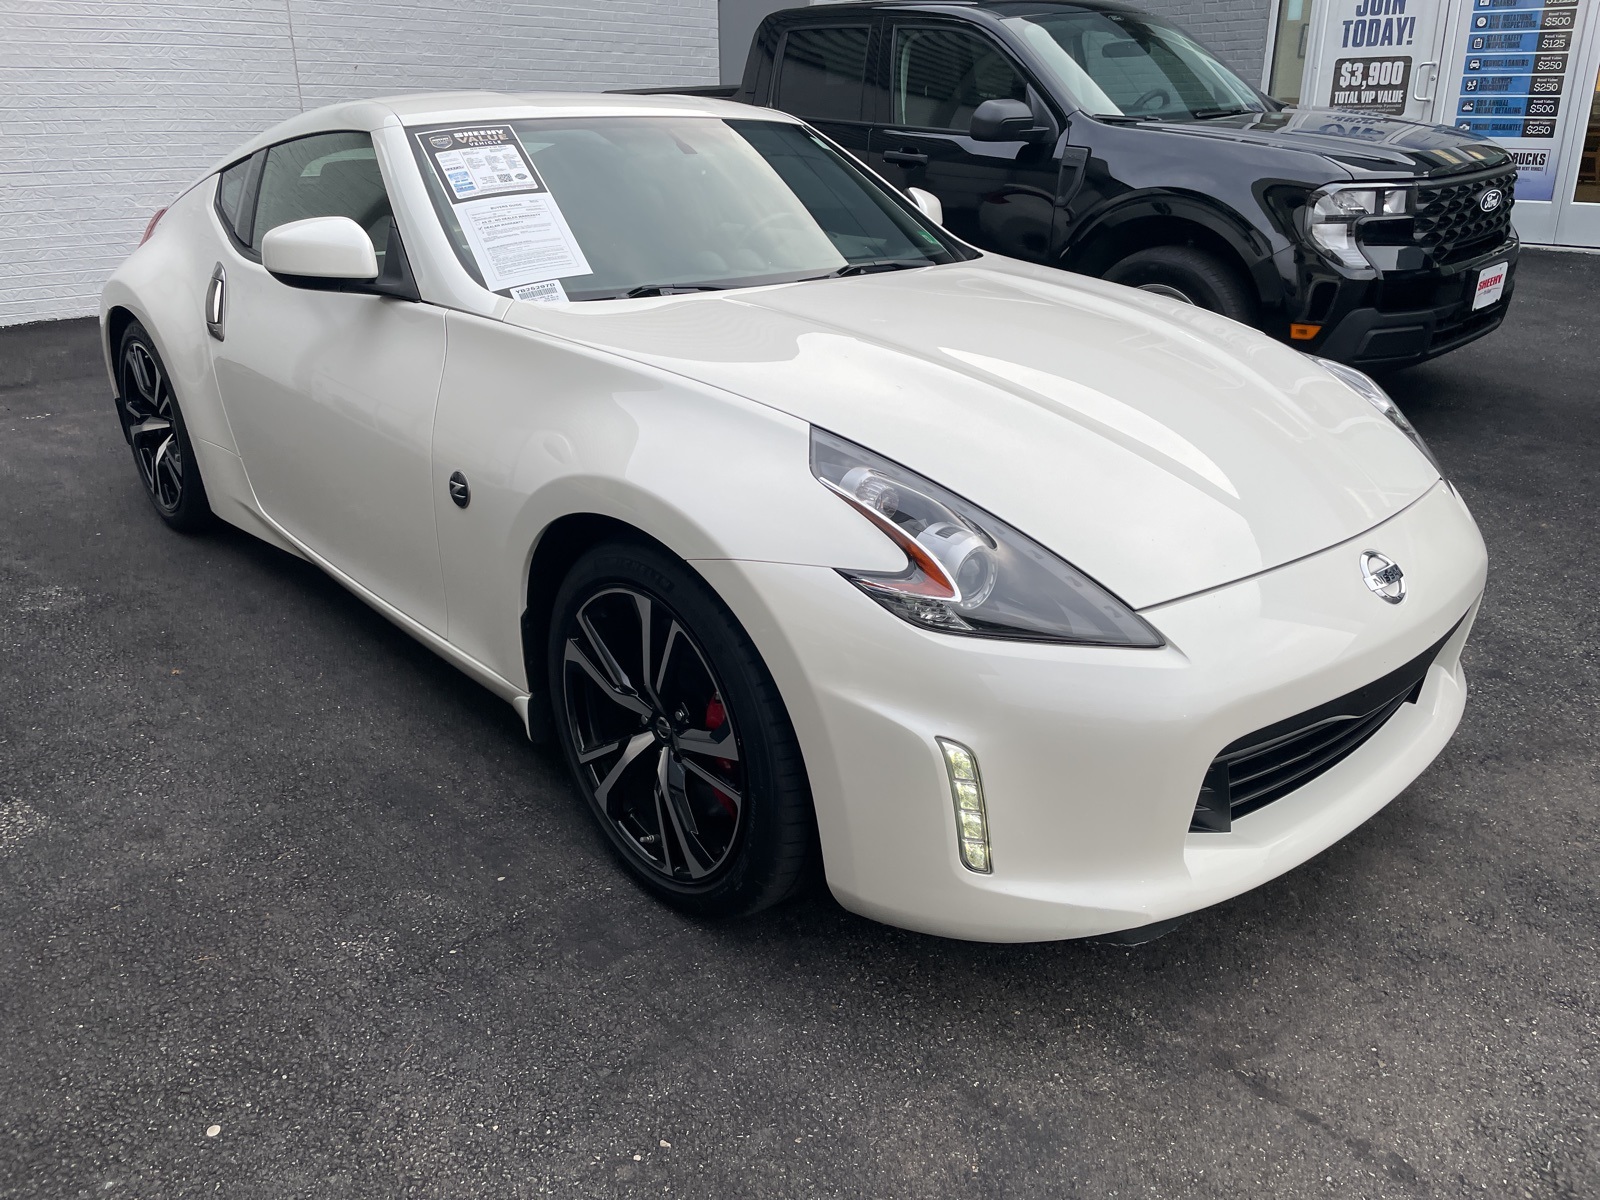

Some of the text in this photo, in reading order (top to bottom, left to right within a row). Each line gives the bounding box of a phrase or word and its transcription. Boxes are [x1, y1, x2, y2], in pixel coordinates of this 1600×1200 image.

[1356, 0, 1407, 16] JOIN
[1544, 17, 1570, 26] $500
[1342, 17, 1416, 48] TODAY!
[1542, 39, 1565, 48] $125
[1537, 61, 1562, 70] $250
[1340, 61, 1404, 89] $3,900
[1533, 83, 1558, 92] $250
[1334, 90, 1404, 104] TOTAL VIP VALUE
[1530, 104, 1554, 114] $500
[453, 130, 503, 138] SHEEHY
[1526, 126, 1550, 134] $250
[457, 134, 507, 143] VALUE
[1485, 193, 1499, 209] Ford
[1478, 274, 1503, 291] SHEEHY
